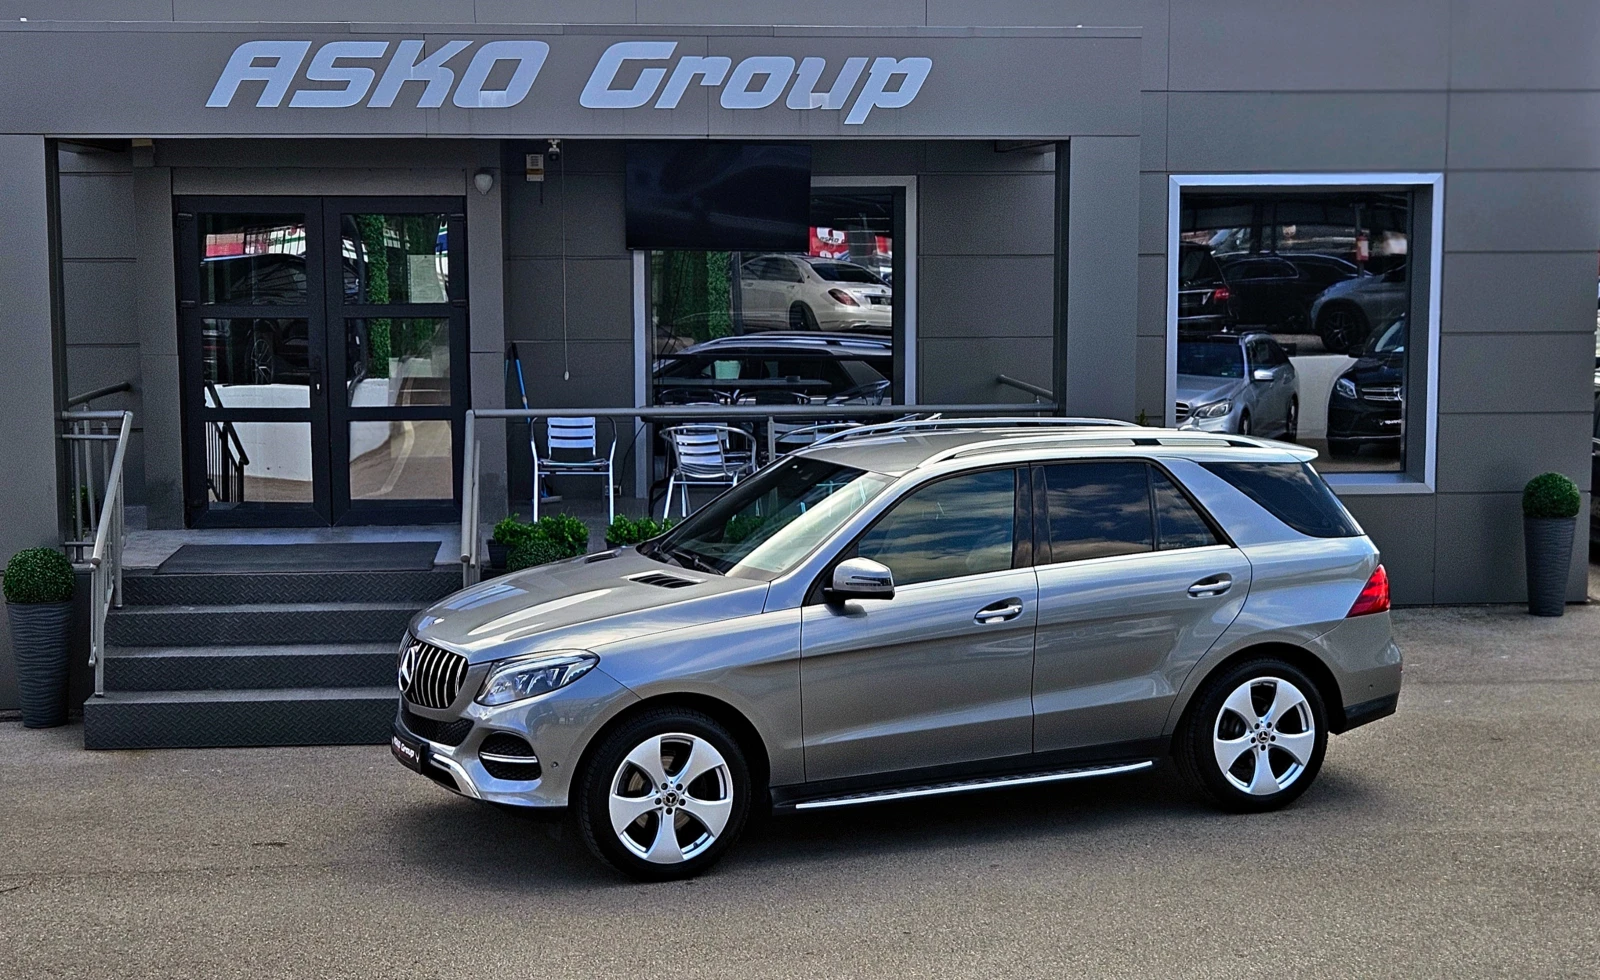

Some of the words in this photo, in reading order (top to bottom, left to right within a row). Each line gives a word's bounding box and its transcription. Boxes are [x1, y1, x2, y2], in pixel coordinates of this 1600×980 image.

[205, 40, 550, 108] ASKO
[579, 41, 933, 124] Group
[401, 743, 415, 759] Group
